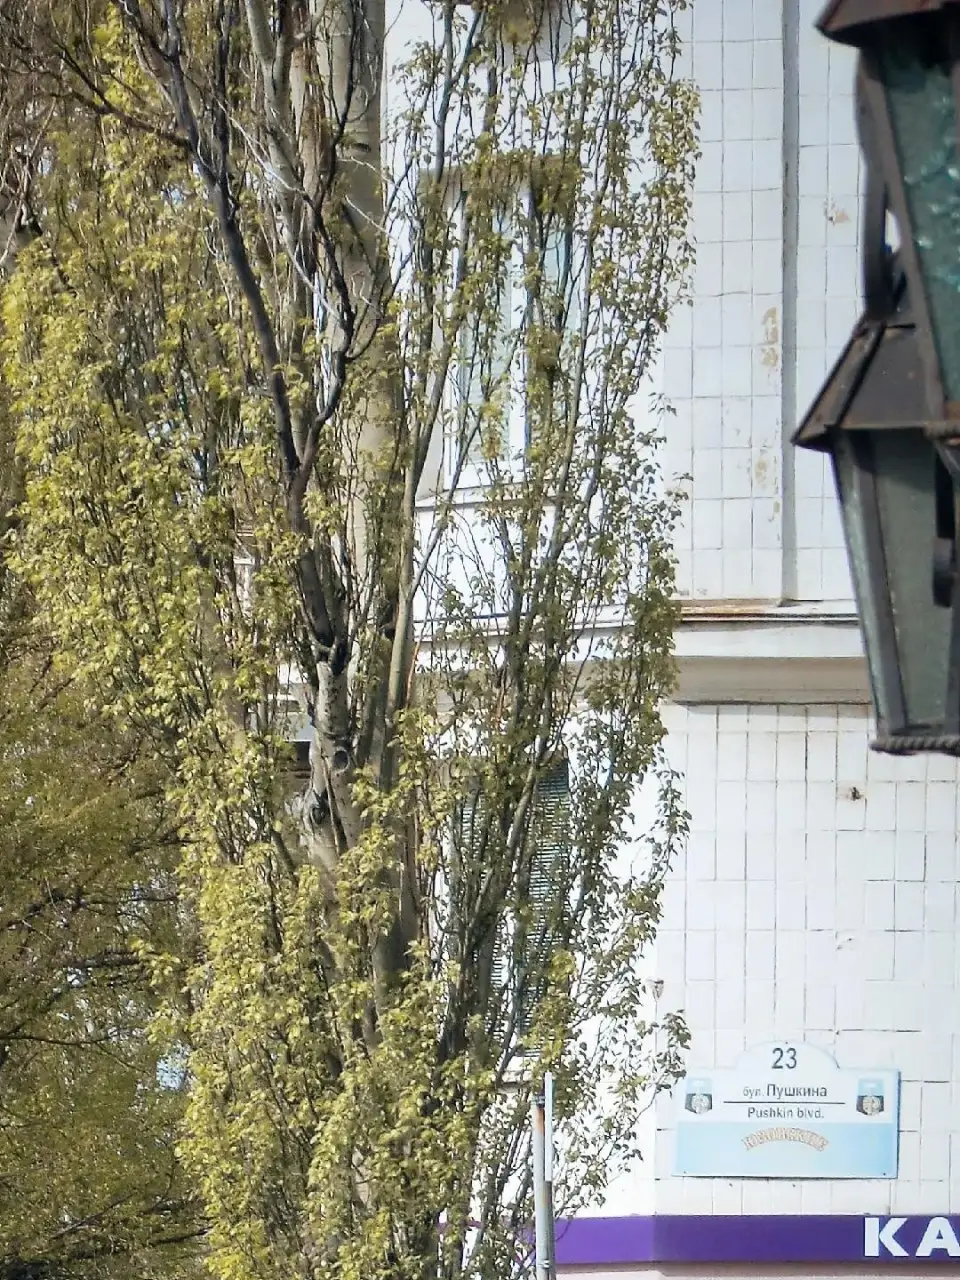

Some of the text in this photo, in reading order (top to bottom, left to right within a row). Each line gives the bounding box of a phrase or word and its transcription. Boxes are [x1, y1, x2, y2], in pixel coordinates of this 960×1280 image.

[771, 1047, 798, 1069] 23
[743, 1083, 828, 1098] бул. Пушкина
[747, 1106, 825, 1119] Pushkin blvd.
